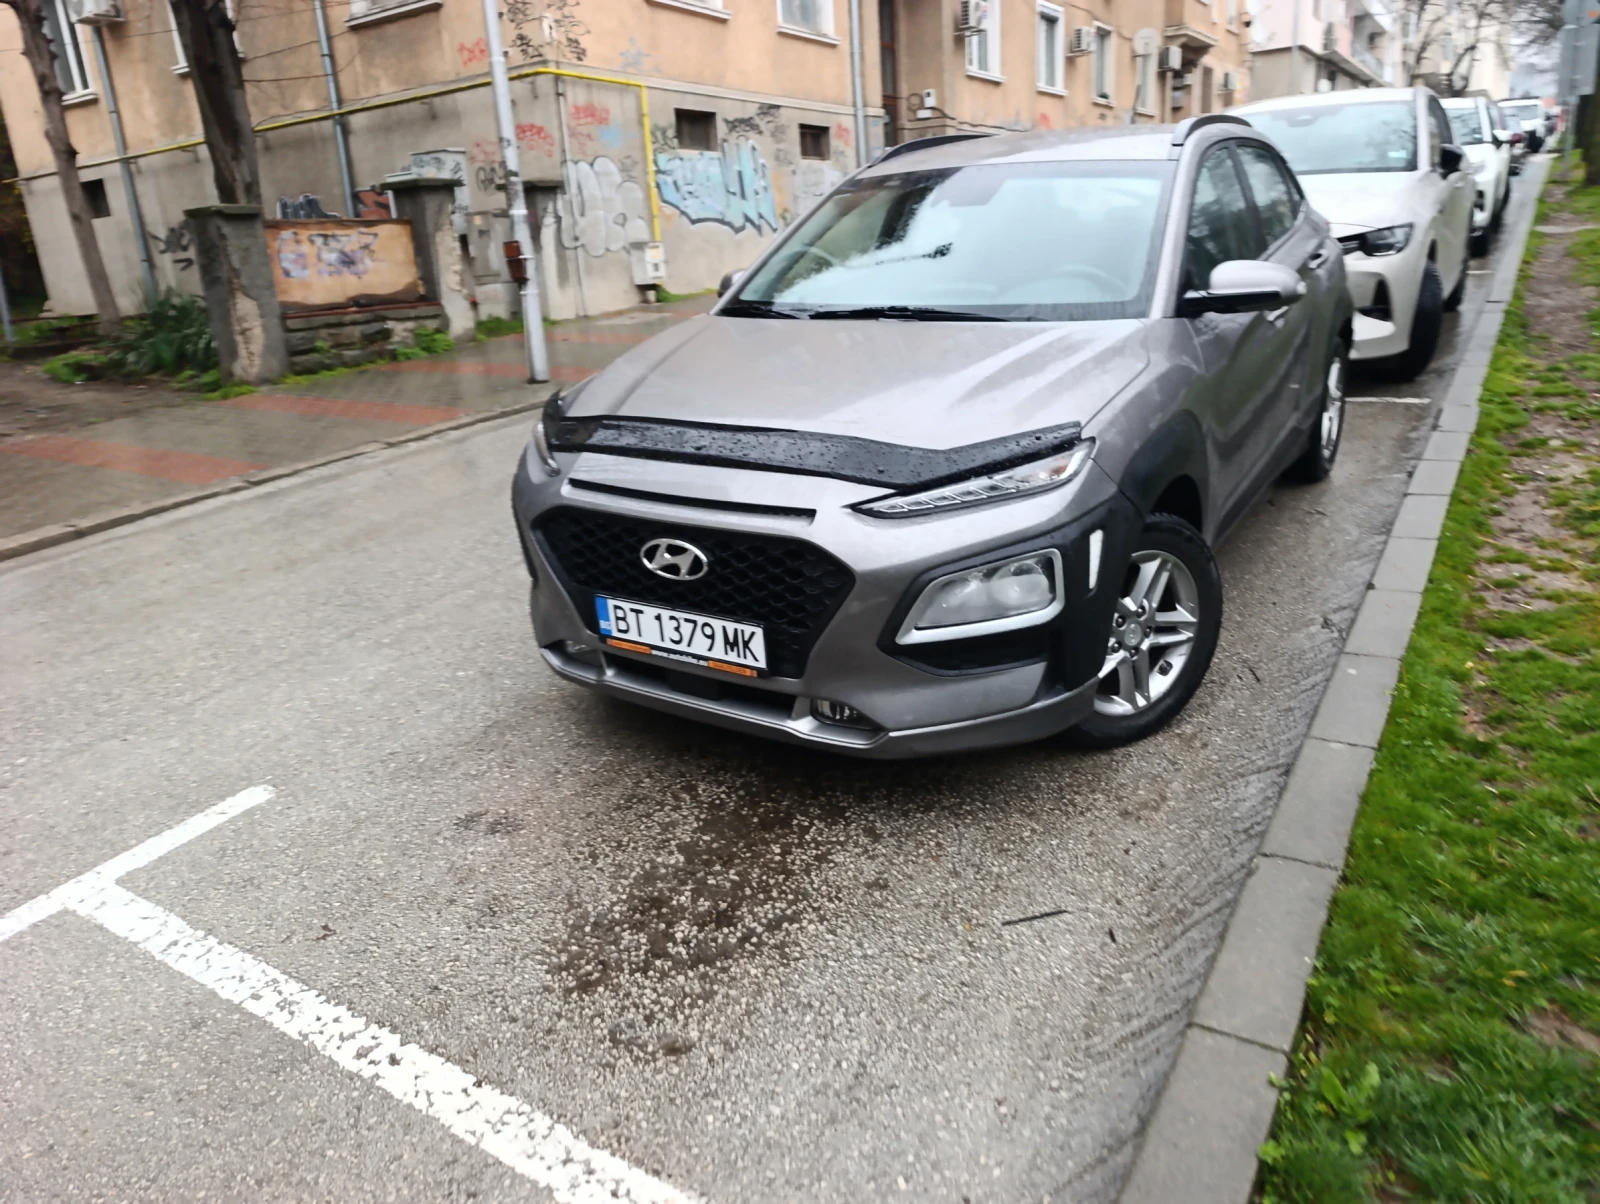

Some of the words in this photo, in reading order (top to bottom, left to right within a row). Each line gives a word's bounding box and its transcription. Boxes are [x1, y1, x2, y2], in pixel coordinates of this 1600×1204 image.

[613, 604, 645, 638] BT
[654, 613, 715, 652] 1379
[722, 625, 759, 663] MK
